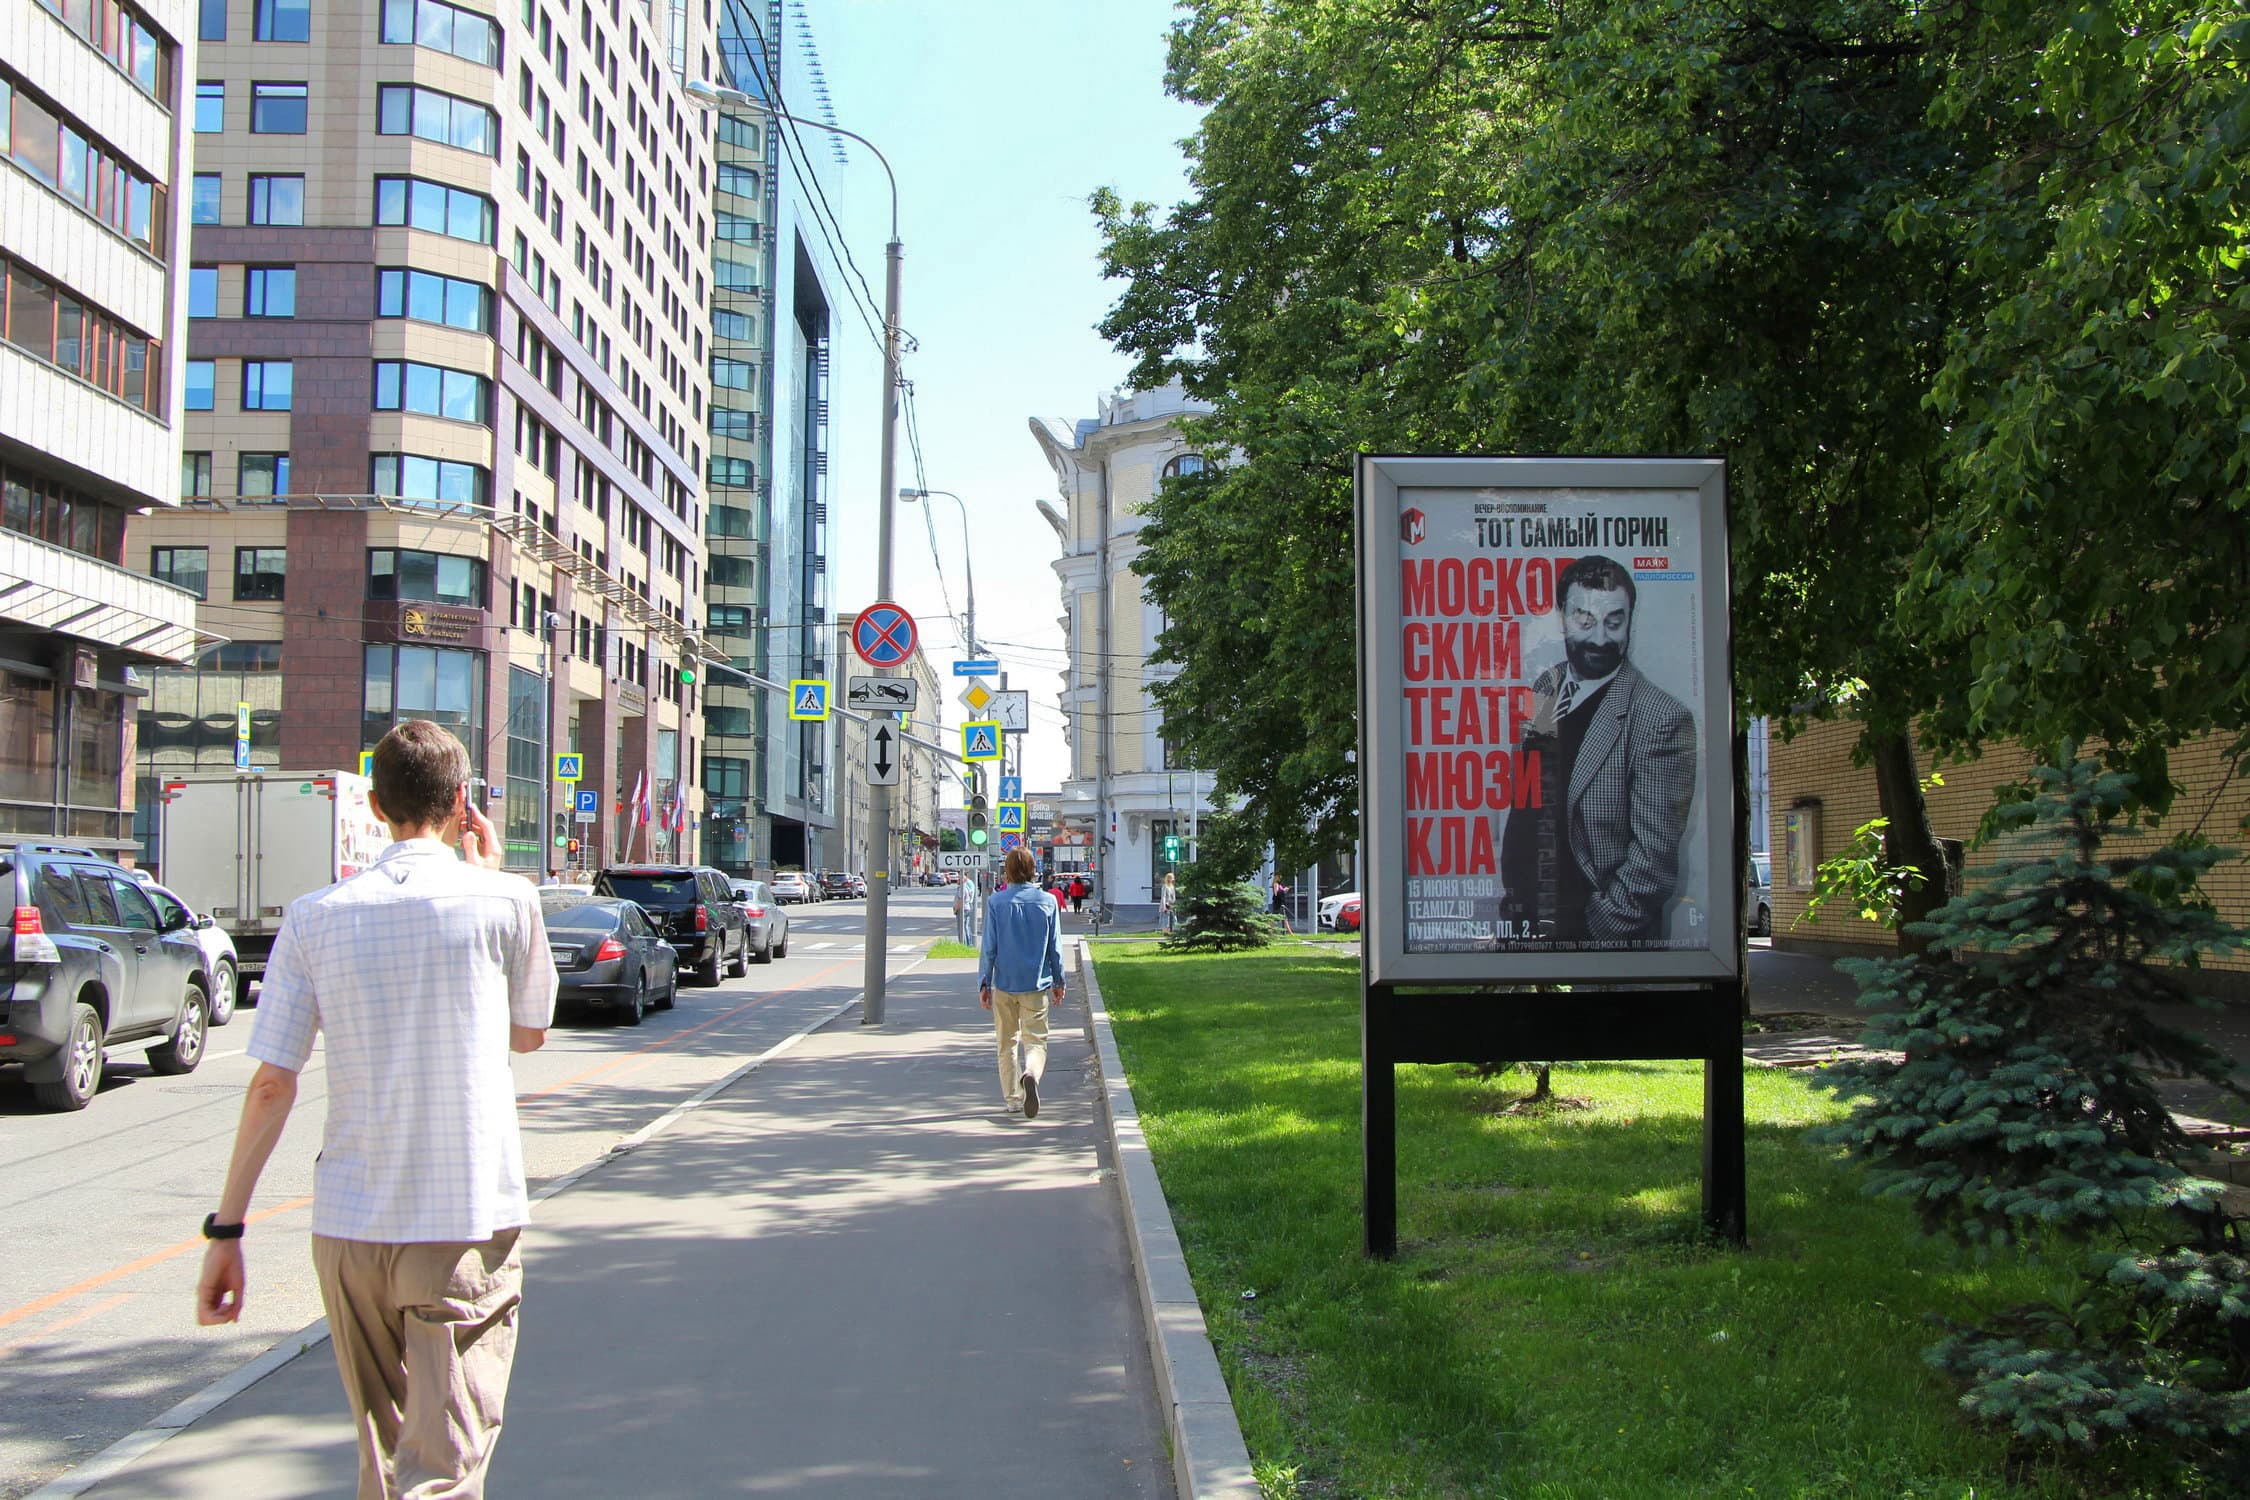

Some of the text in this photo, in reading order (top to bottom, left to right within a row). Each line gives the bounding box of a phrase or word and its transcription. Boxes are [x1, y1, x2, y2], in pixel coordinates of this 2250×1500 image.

[1475, 504, 1548, 514] ВЕЧЕР-ВОСПОМИНАНИЕ
[1474, 512, 1669, 548] ТОТ САМЫЙ ГОРИН
[1637, 559, 1665, 568] МАЯК
[1403, 616, 1522, 682] СКИЙ
[1404, 686, 1535, 745] ТЕАТР
[1406, 750, 1543, 811] МЮЗИ
[581, 793, 593, 810] P
[1407, 816, 1497, 876] КЛА
[944, 855, 981, 866] СТОП
[1408, 880, 1421, 898] 15
[1423, 880, 1459, 898] ИЮНЯ
[1462, 879, 1494, 898] 19:00
[1408, 900, 1475, 919] TEAMUZ.RU
[1688, 907, 1705, 927] 6+
